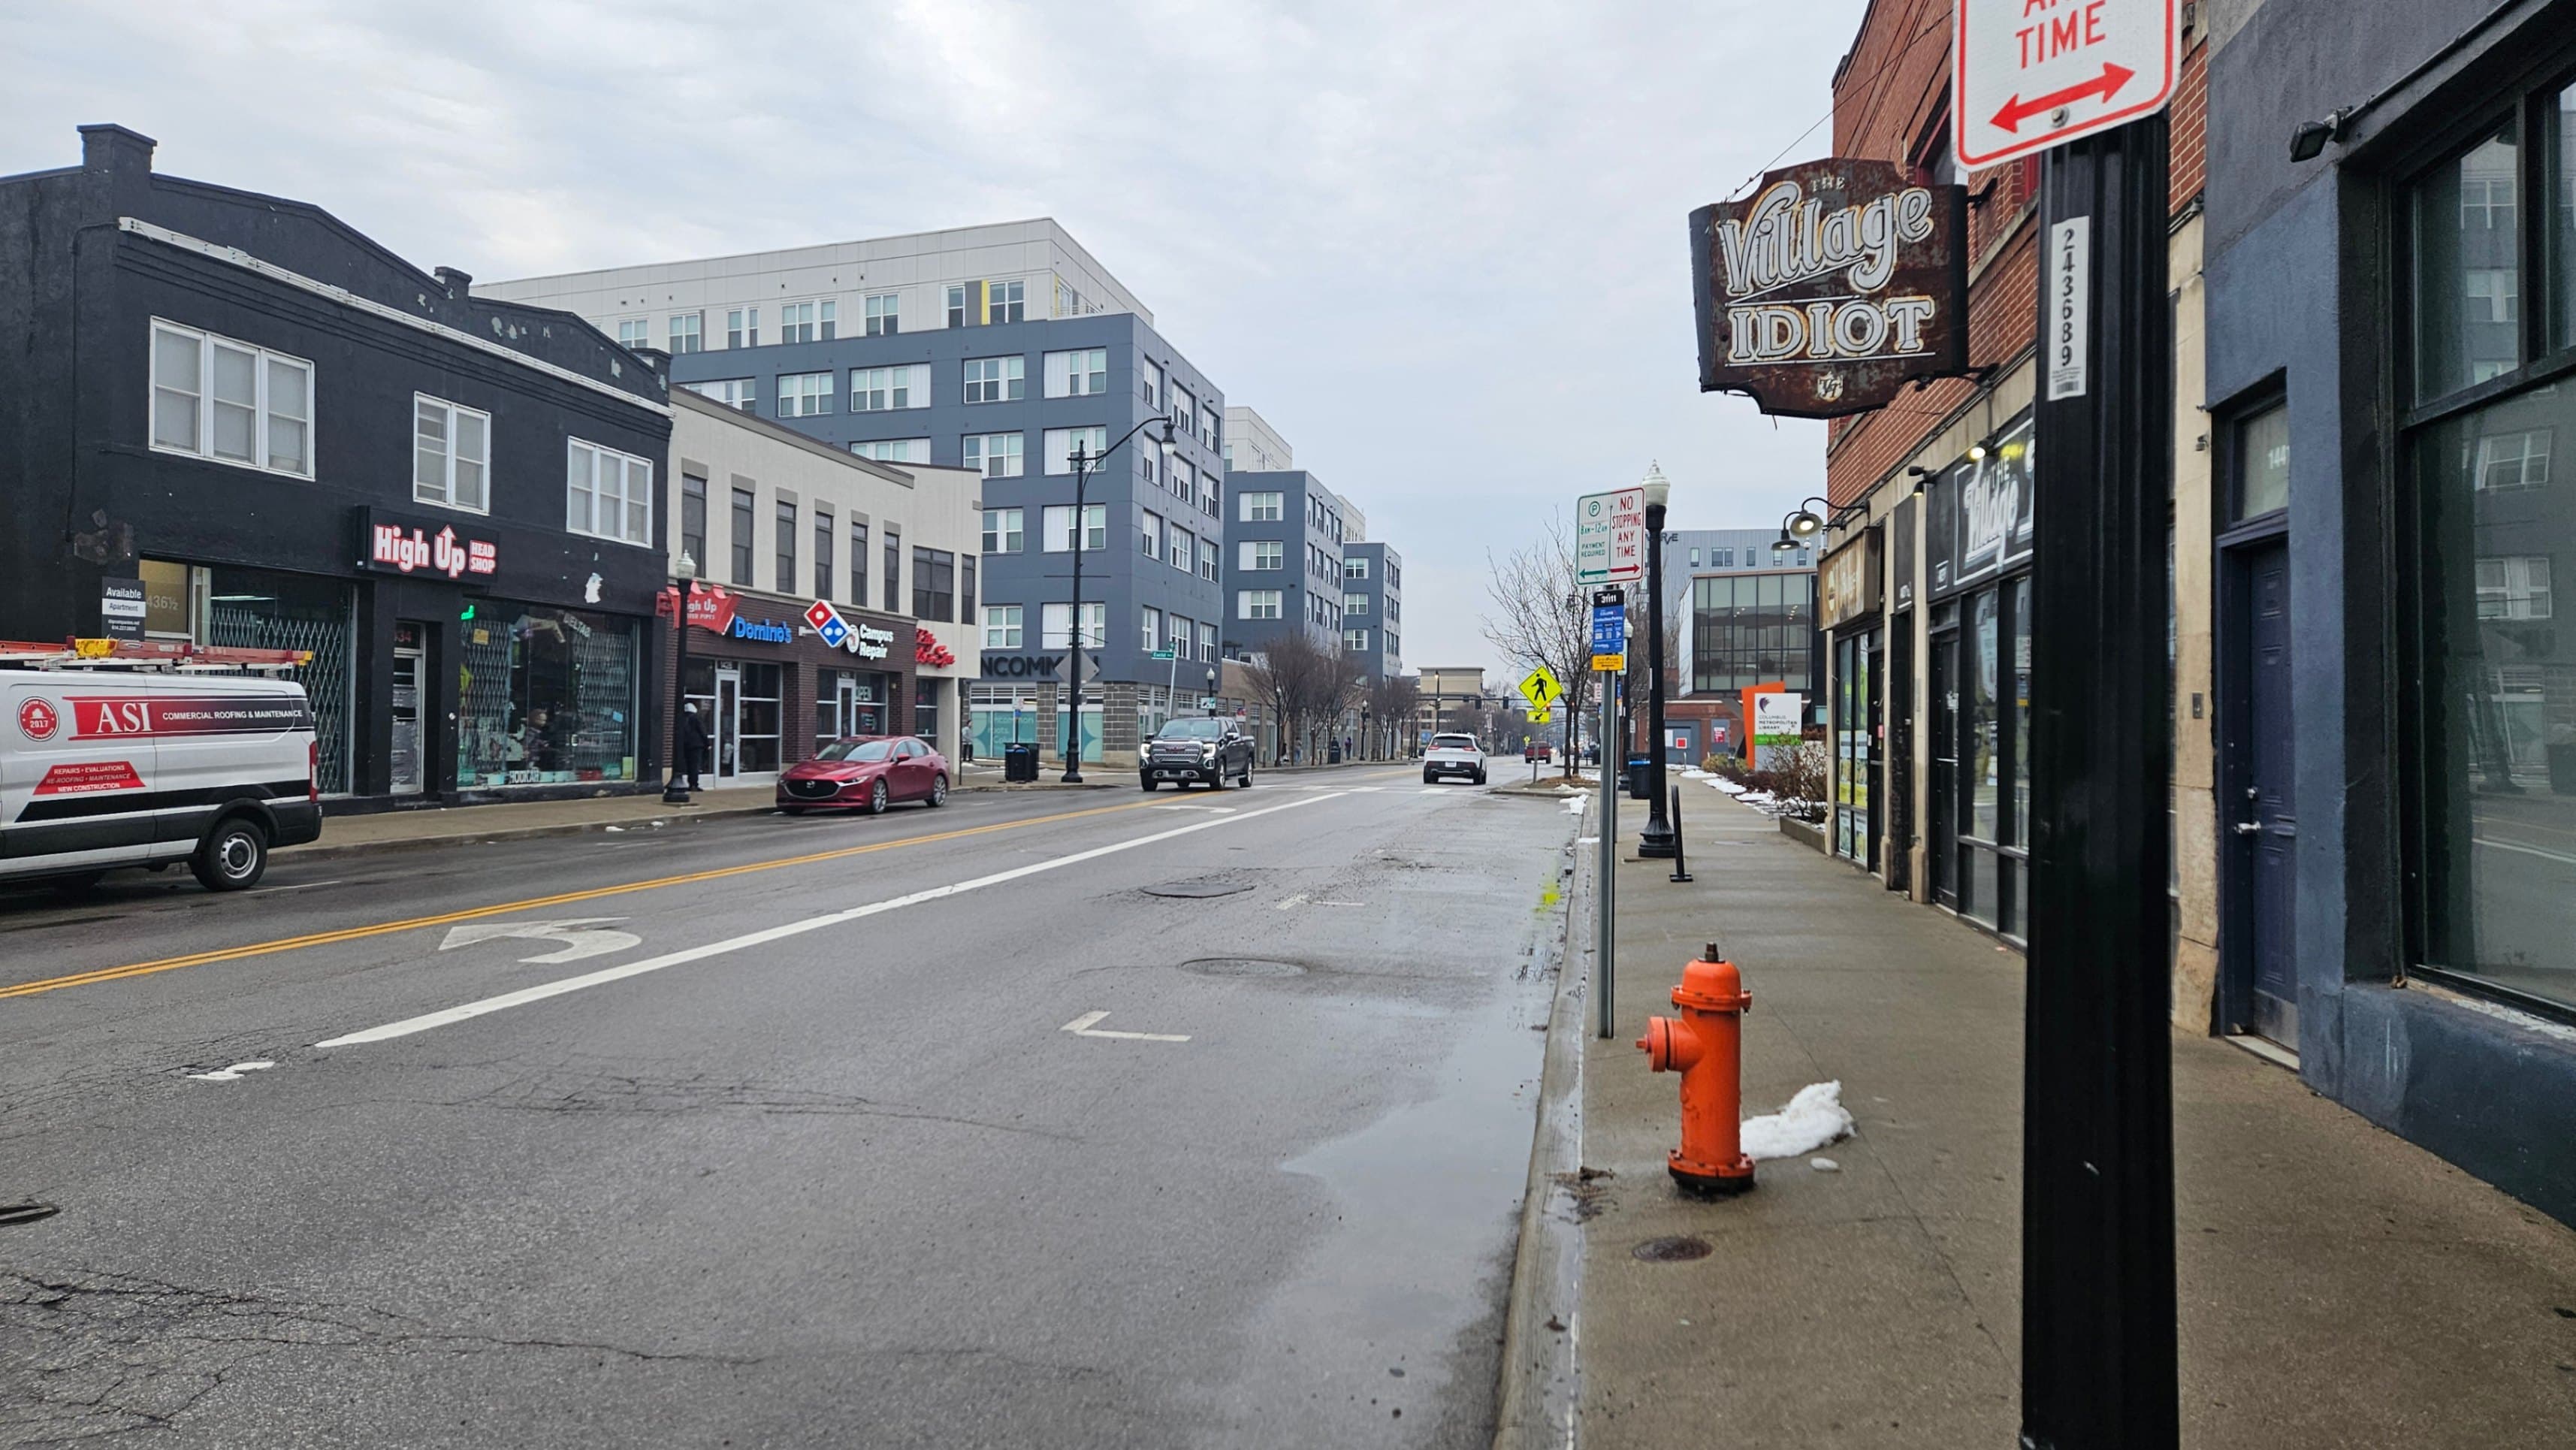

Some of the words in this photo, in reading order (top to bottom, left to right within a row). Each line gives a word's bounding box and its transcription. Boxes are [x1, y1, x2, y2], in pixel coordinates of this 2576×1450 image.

[2016, 0, 2106, 69] TIME
[1809, 176, 1847, 192] THE
[1717, 180, 1934, 296] Village
[2061, 228, 2076, 366] 243689
[1729, 295, 1936, 363] IDIOT
[1620, 495, 1633, 511] NO
[1612, 512, 1641, 529] STOPPING
[1617, 530, 1635, 543] ANY
[373, 524, 430, 572] High
[433, 524, 466, 578] Up
[470, 539, 496, 557] HEAD
[1581, 542, 1605, 550] PAYMENT
[1617, 545, 1635, 558] TIME
[469, 556, 496, 574] SHOP
[106, 587, 142, 599] Available
[109, 602, 139, 612] Apartment
[687, 600, 701, 613] igh
[704, 598, 717, 613] Up
[735, 616, 793, 644] Domino's
[860, 623, 894, 643] Campus
[859, 642, 888, 660] Repair
[96, 702, 153, 733] ASI
[162, 711, 213, 720] COMMERCIAL
[214, 711, 246, 719] ROOFING
[255, 709, 303, 718] MAINTENANCE
[30, 720, 48, 728] 2017
[85, 765, 125, 773] EVALUATIONS
[89, 772, 131, 781] MAINTENANCE
[74, 782, 119, 791] CONSTRUCTION
